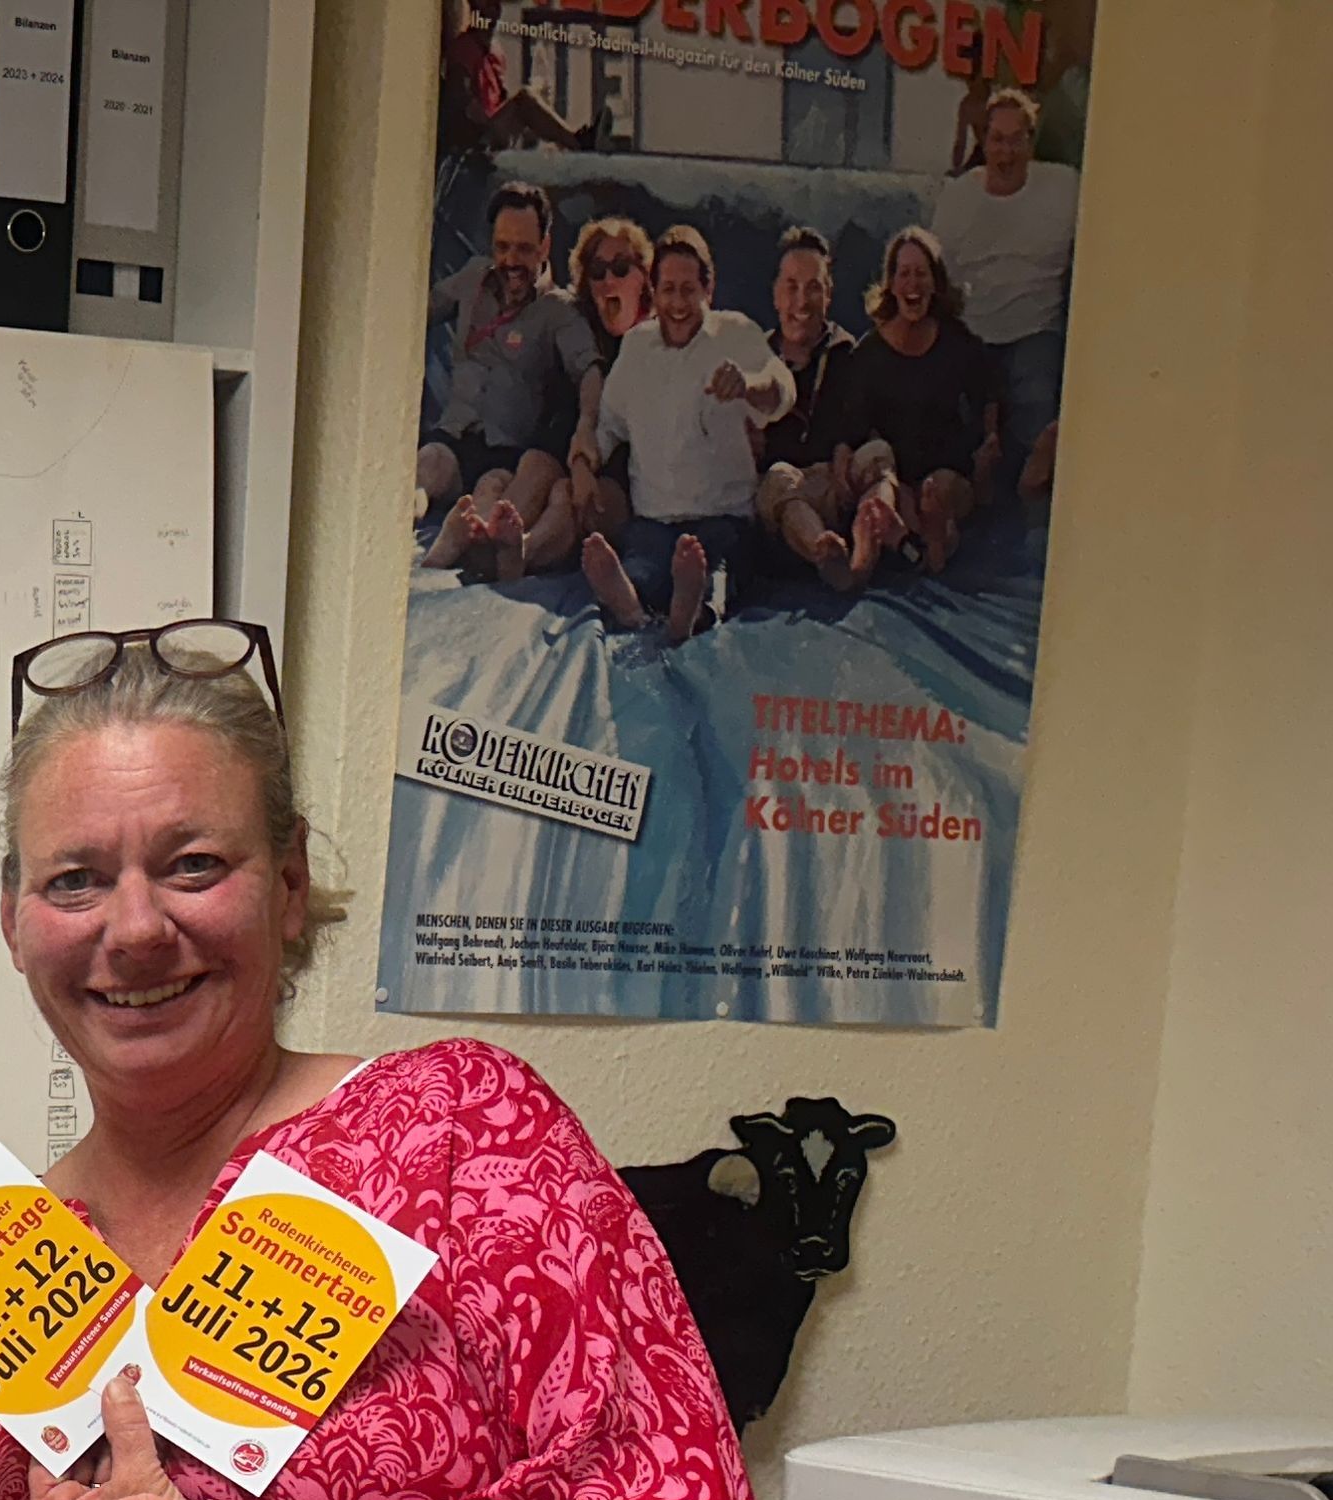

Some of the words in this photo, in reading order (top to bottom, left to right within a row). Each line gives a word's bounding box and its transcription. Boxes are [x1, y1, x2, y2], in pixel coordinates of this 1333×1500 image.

[14, 17, 57, 32] Bilanzen
[471, 12, 491, 30] Ihr
[497, 19, 583, 46] monatliches
[588, 31, 715, 66] Stadtteil-Magazin
[719, 53, 740, 70] für
[745, 54, 770, 75] den
[775, 60, 820, 83] Kölner
[824, 66, 866, 91] Süden
[3, 67, 28, 81] 2023
[40, 71, 65, 85] 2024
[112, 49, 151, 64] Bilanzen
[752, 693, 967, 745] TITELTHEMA:
[422, 714, 644, 810] RODENKIRCHEN
[749, 745, 860, 786] Hotels
[873, 753, 913, 789] im
[417, 757, 499, 793] KÖLNER
[499, 780, 634, 831] BILDERBOGEN
[745, 796, 865, 835] Kölner
[877, 801, 982, 841] Süden
[416, 914, 471, 931] MENSCHEN,
[475, 916, 506, 930] DENEN
[510, 917, 524, 931] SIE
[526, 918, 537, 931] IN
[540, 919, 572, 933] DIESER
[576, 920, 619, 934] AUSGABE
[416, 933, 460, 951] Wolfgang
[14, 1238, 80, 1290] 12.
[220, 1210, 387, 1324] Sommertage
[257, 1207, 377, 1286] Rodenkirchener
[28, 1252, 116, 1340] 2026
[201, 1250, 255, 1311] 11.
[284, 1301, 342, 1361] 12.
[49, 1320, 104, 1384] Verkaufsoffener
[99, 1289, 131, 1324] Sonntag
[161, 1283, 239, 1342] Juli
[232, 1325, 333, 1402] 2026
[187, 1360, 260, 1402] Verkaufsoffener
[259, 1395, 299, 1421] Sonntag
